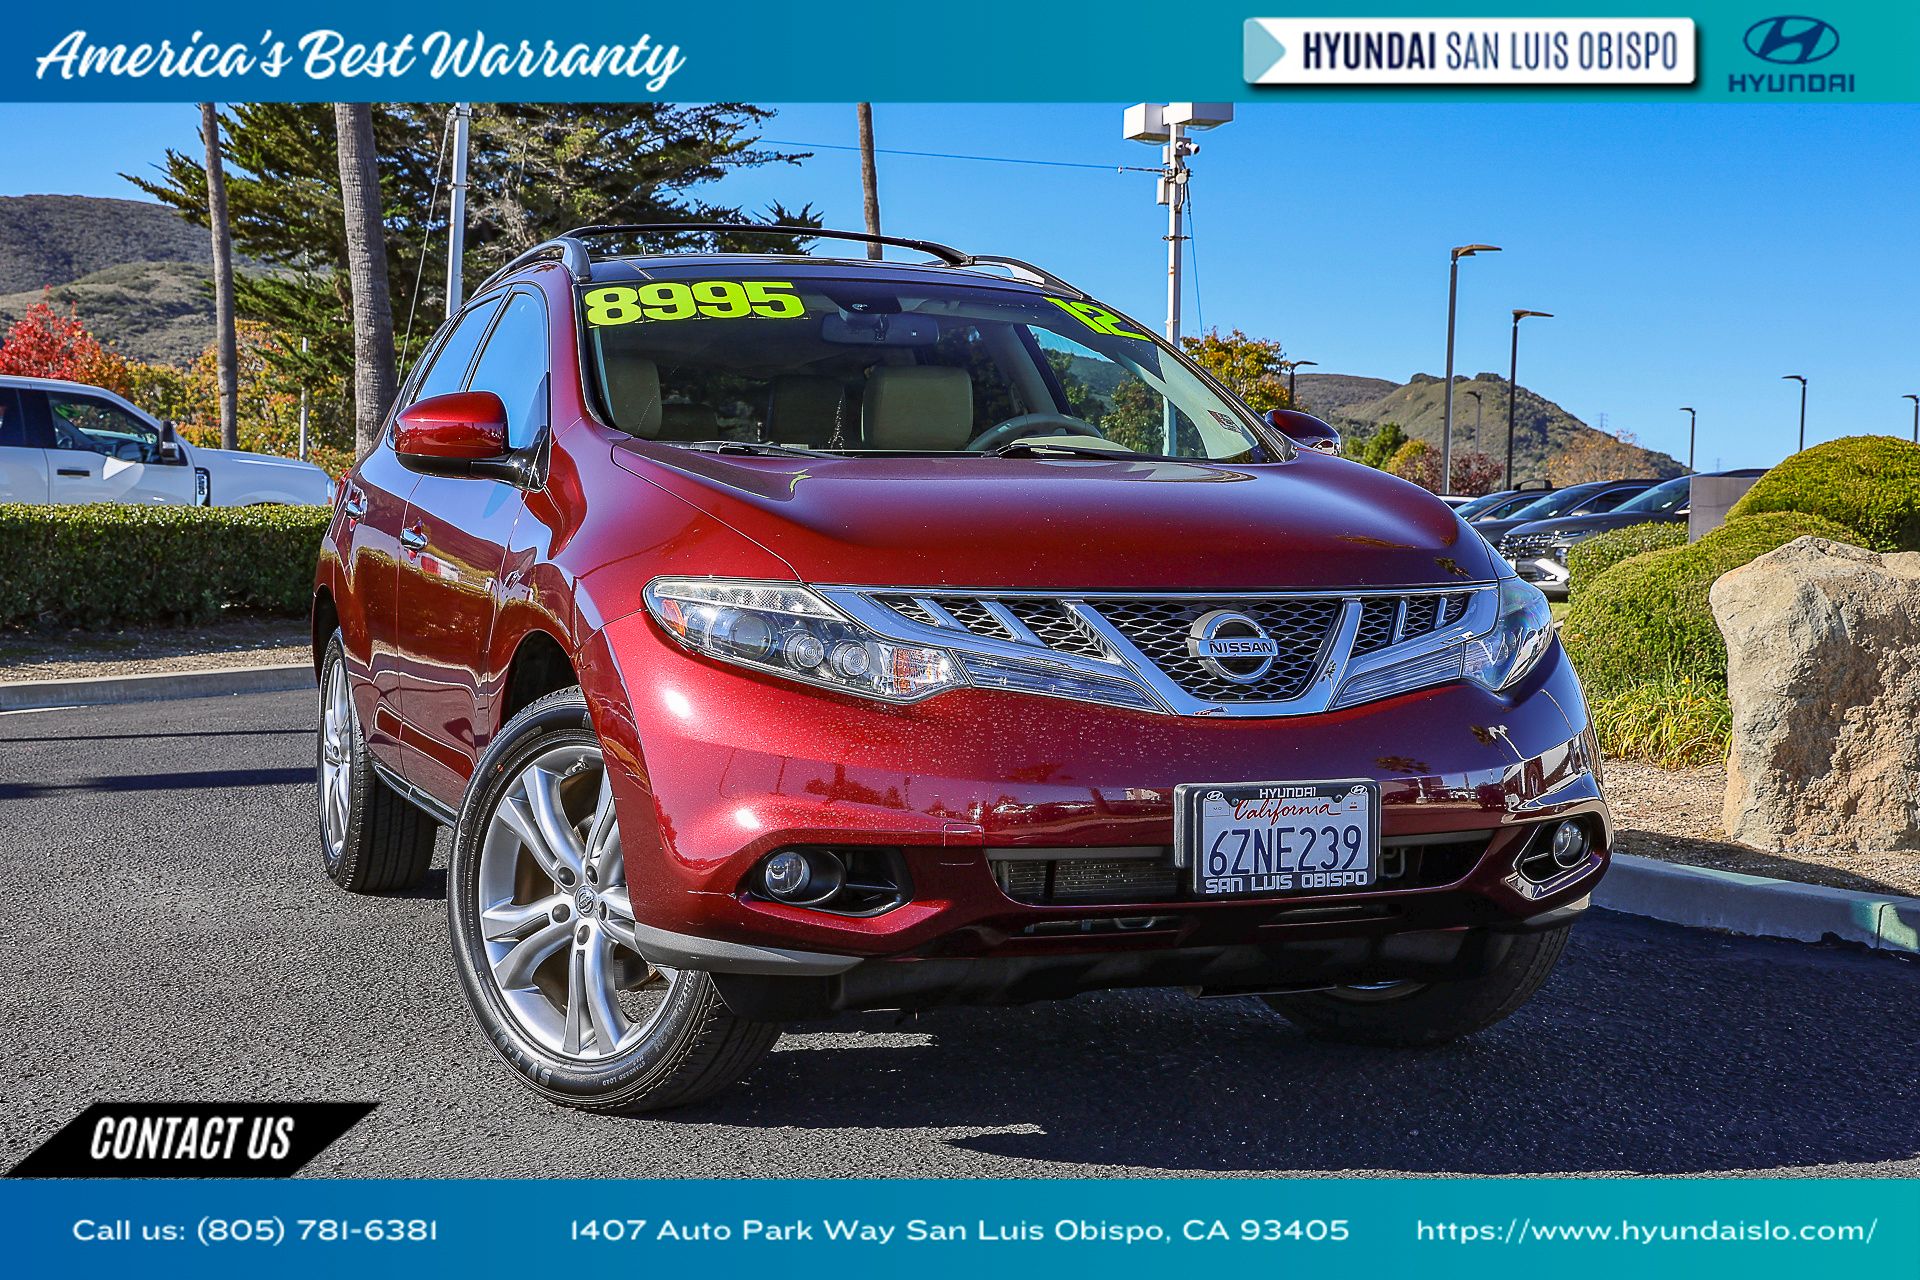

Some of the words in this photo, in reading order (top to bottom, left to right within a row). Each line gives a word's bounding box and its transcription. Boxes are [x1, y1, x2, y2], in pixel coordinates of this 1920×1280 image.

[584, 280, 805, 326] 8995
[1043, 296, 1152, 342] 12
[1208, 642, 1274, 654] NISSAN
[1258, 786, 1317, 799] HYUNDAI
[1233, 799, 1342, 826] California
[1207, 824, 1363, 877] 6ZNE239
[1205, 877, 1244, 894] SAN
[1251, 874, 1294, 891] LUIS
[1301, 871, 1369, 889] OBISPO
